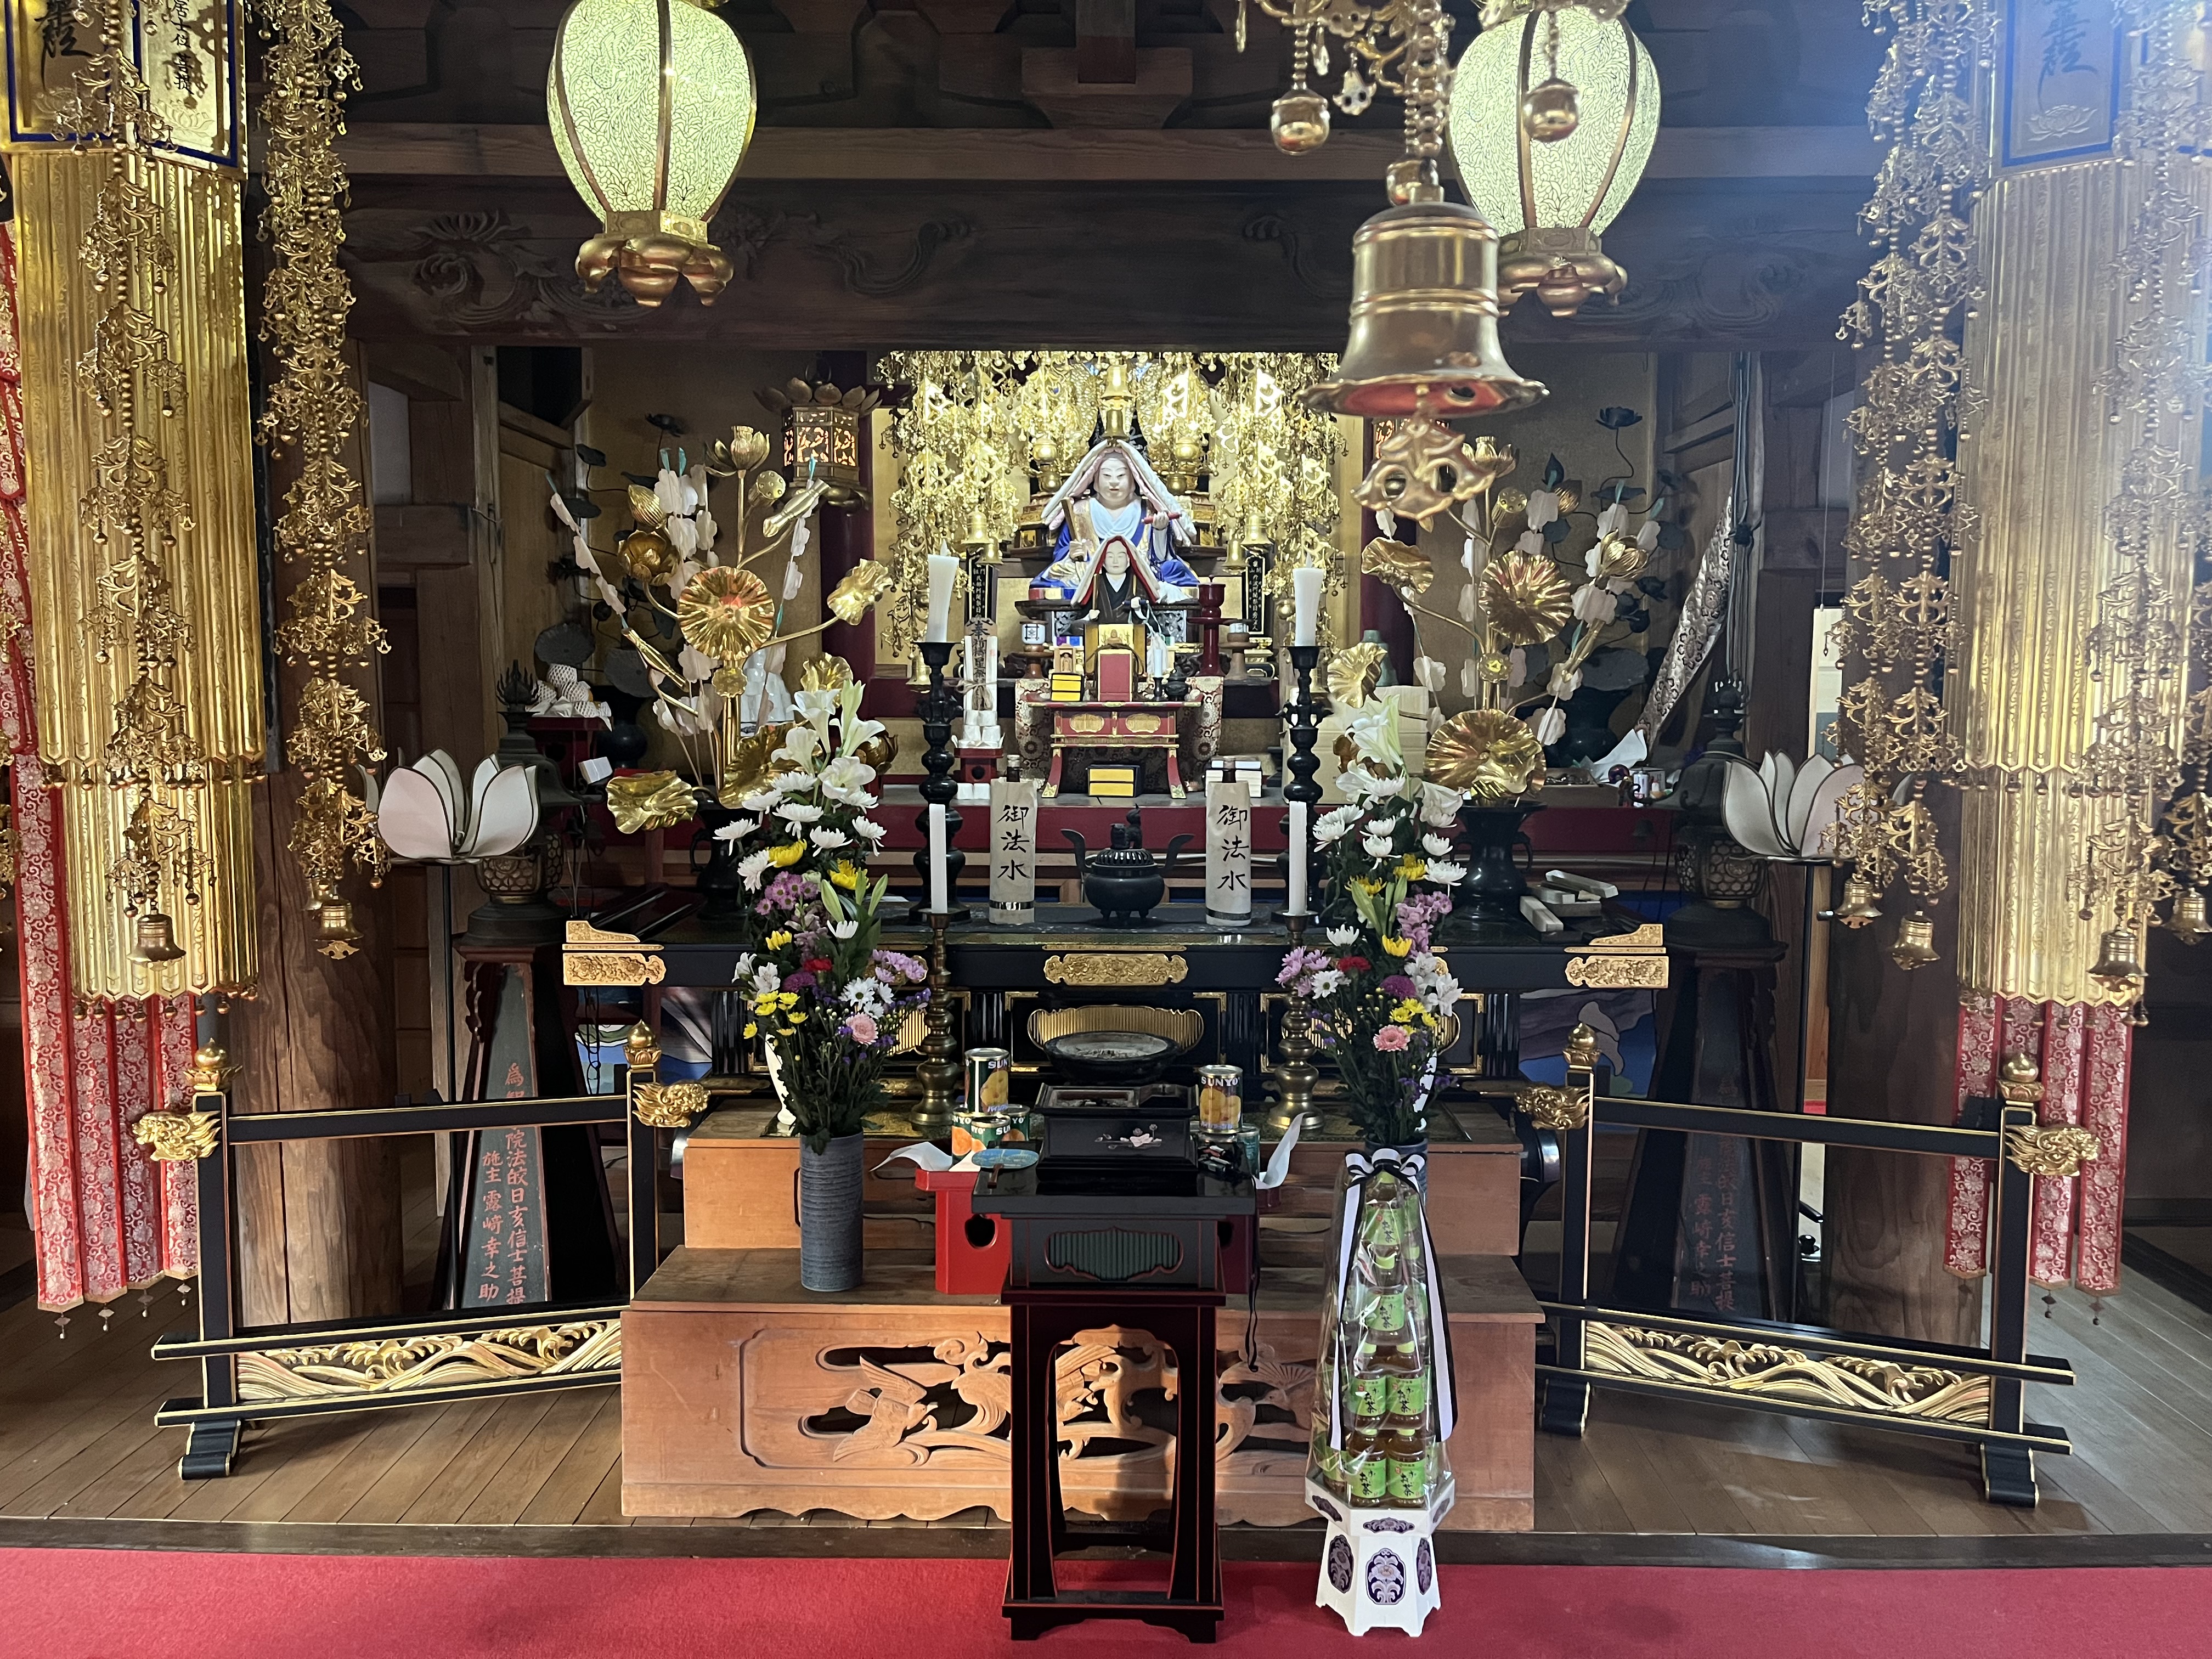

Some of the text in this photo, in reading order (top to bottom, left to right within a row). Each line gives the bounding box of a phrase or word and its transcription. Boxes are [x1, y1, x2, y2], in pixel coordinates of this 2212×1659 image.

[996, 805, 1031, 880] 御法水
[1215, 805, 1250, 890] 御法水
[1201, 1076, 1239, 1087] SUNYO
